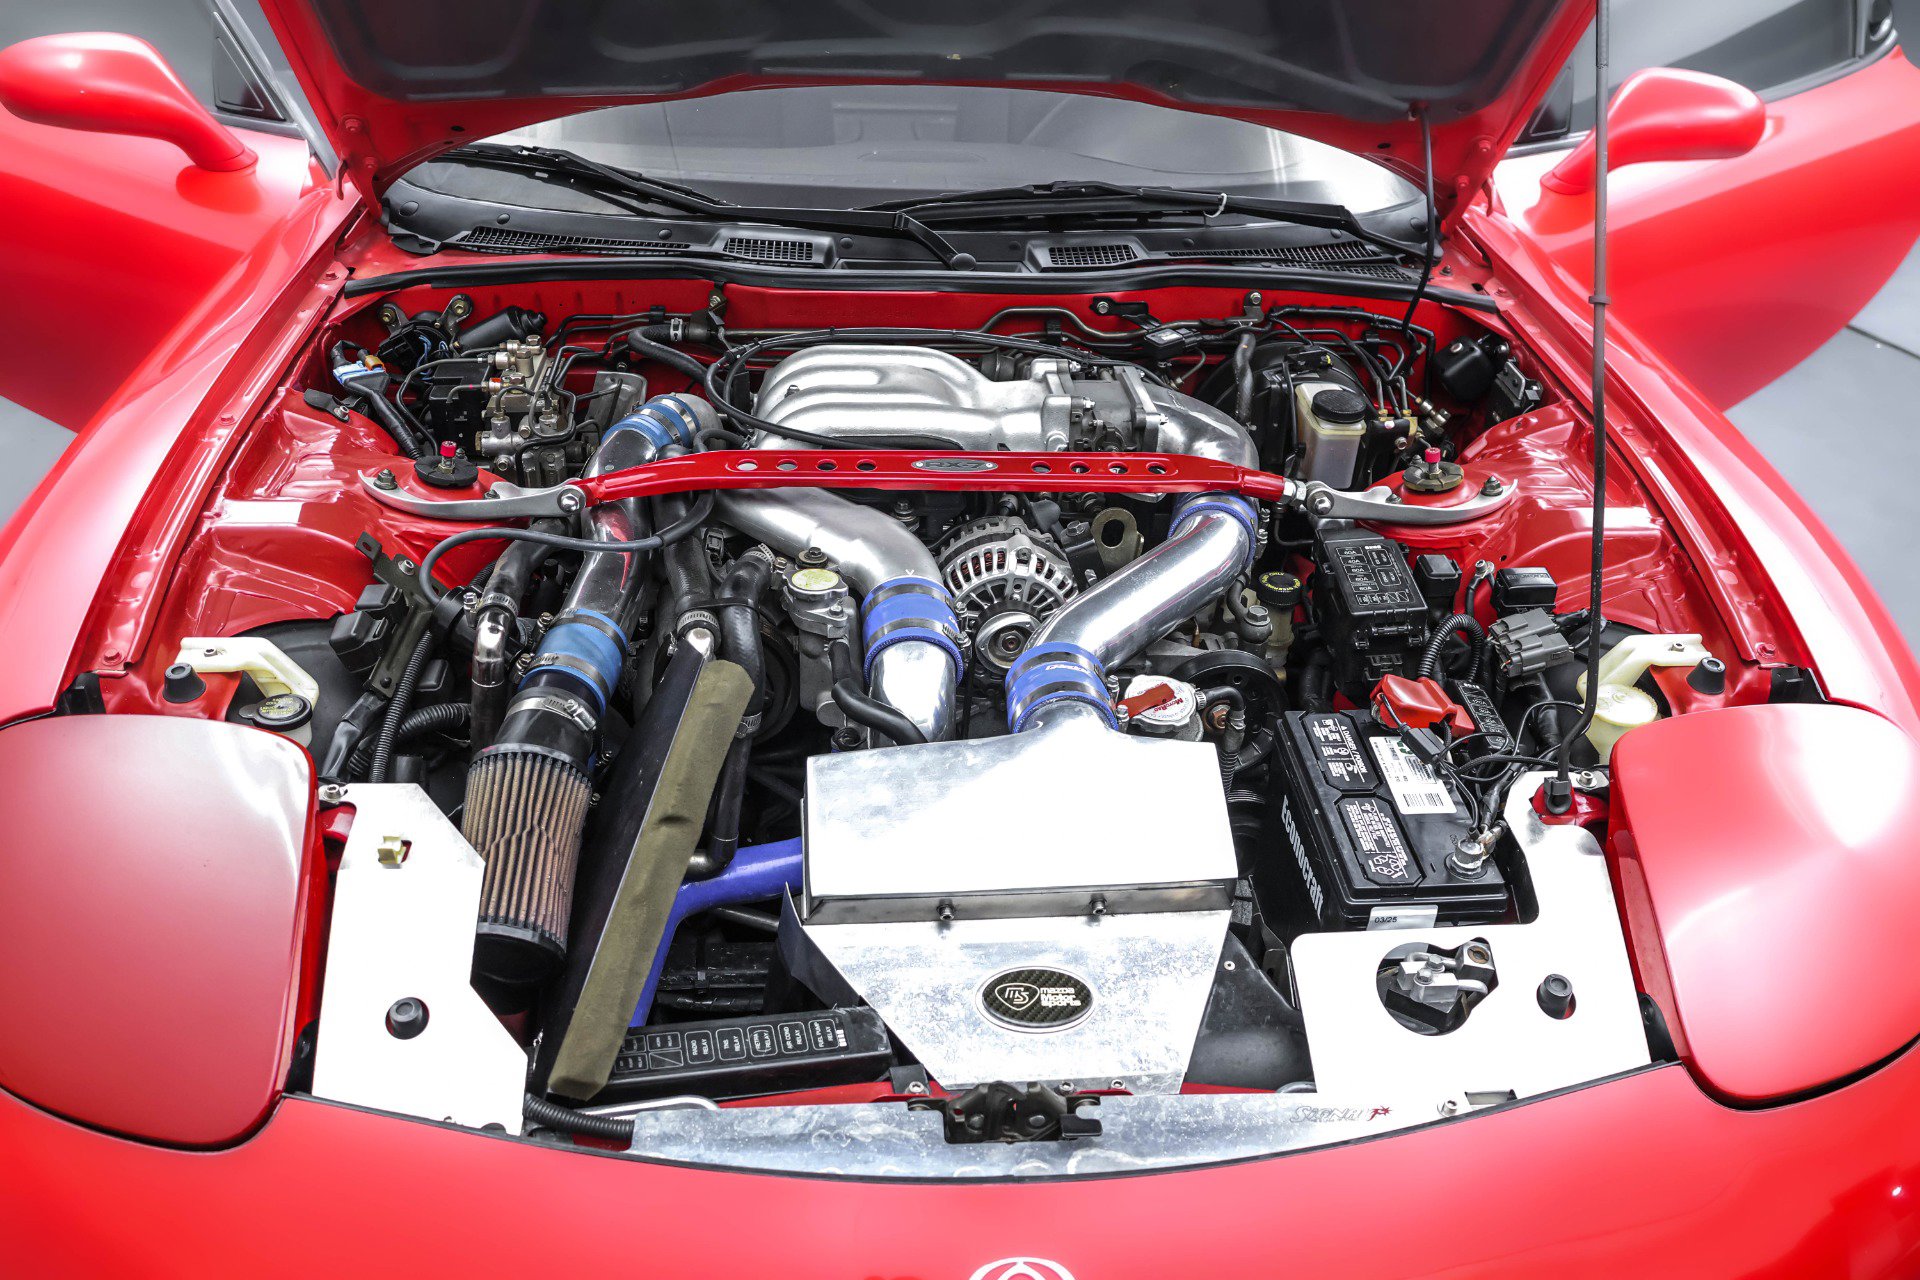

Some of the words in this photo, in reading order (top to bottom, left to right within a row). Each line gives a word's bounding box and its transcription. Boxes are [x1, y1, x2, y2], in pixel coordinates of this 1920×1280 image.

[1343, 730, 1358, 751] DANGER
[1281, 794, 1324, 920] Econocraft
[816, 1035, 824, 1048] FUEL
[825, 1026, 833, 1042] RELAY
